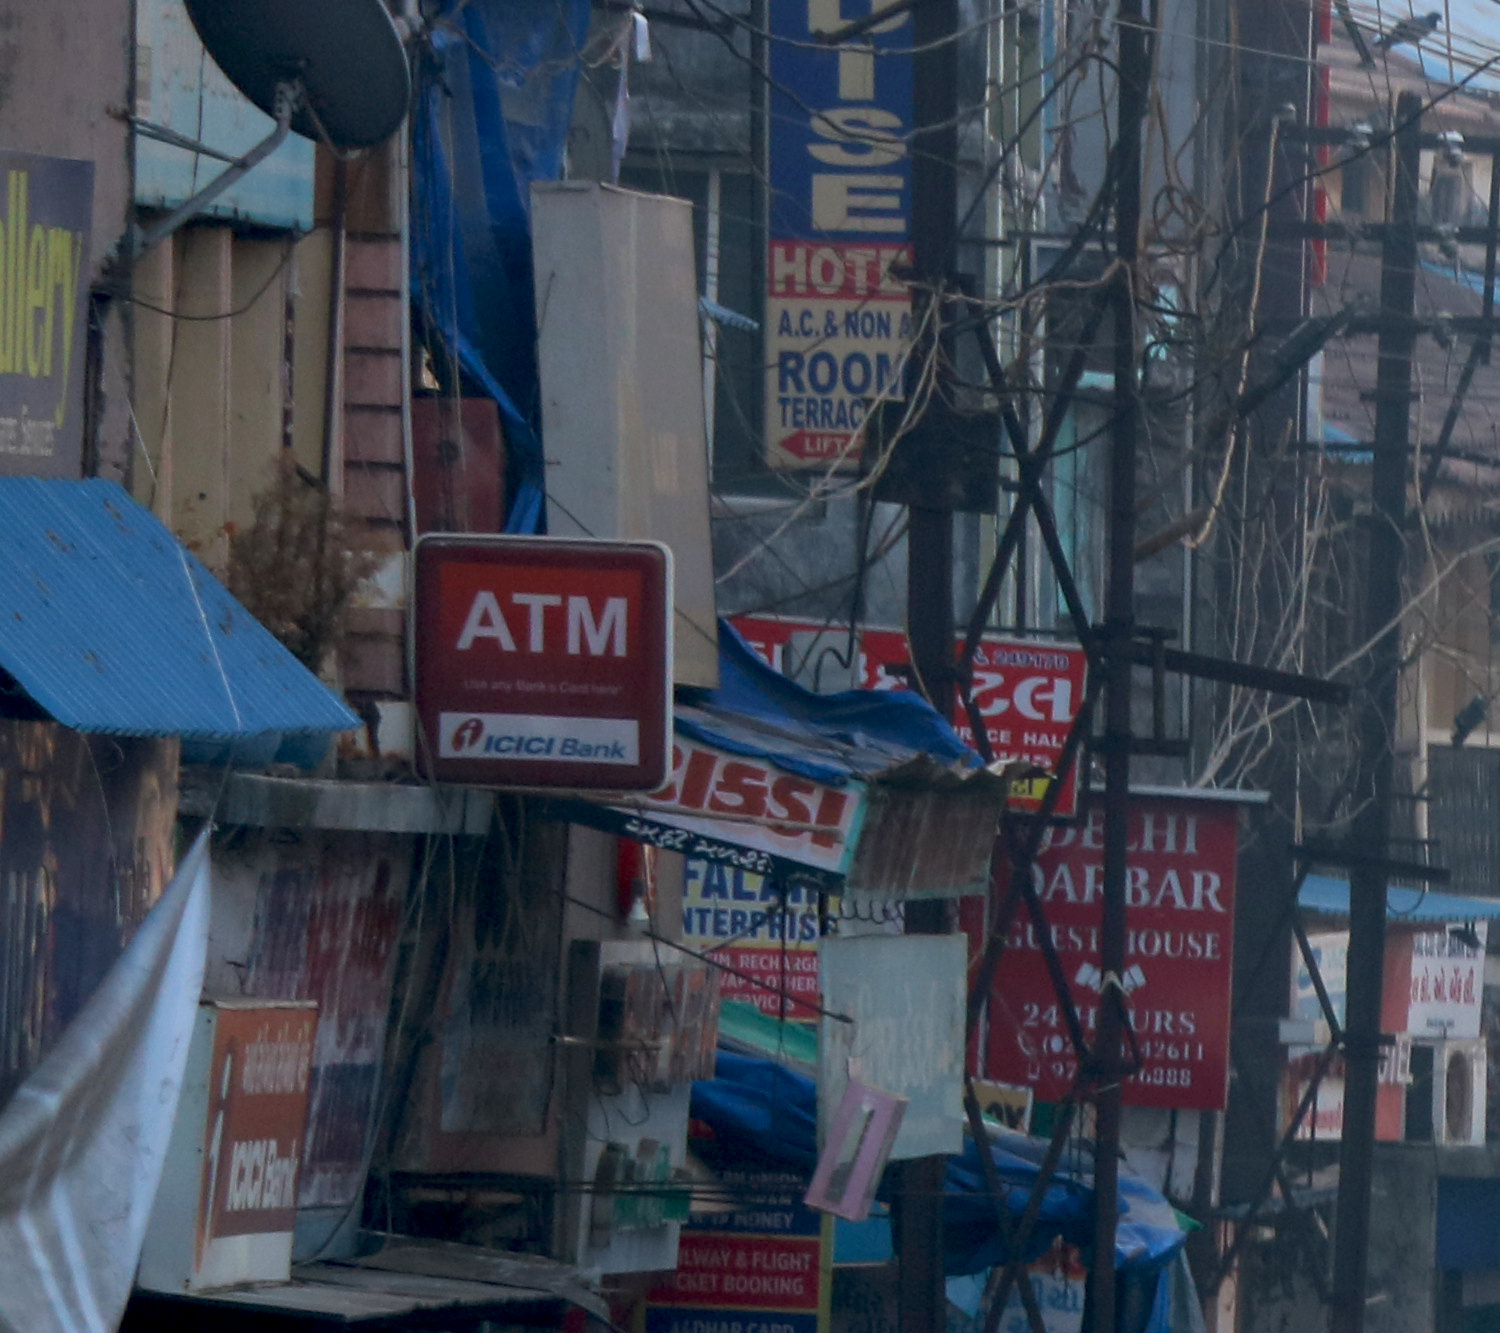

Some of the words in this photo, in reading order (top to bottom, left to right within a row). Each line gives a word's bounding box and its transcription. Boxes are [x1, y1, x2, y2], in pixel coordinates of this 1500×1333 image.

[773, 245, 909, 295] HOTE
[0, 168, 82, 430] llery
[824, 312, 838, 338] &
[845, 310, 891, 338] NON
[779, 398, 866, 429] TERRAC
[456, 589, 629, 658] ATM
[485, 734, 555, 754] ICICI
[559, 737, 626, 760] Bank
[682, 905, 840, 943] NTERPRISE
[767, 976, 817, 990] OHER
[1023, 1002, 1059, 1028] 24
[1074, 1005, 1197, 1036] HURS
[680, 1249, 730, 1268] ILWAY
[736, 1251, 748, 1269] &
[752, 1251, 812, 1271] FLIGHT
[675, 1273, 718, 1294] CKET
[722, 1274, 805, 1296] BOOKING
